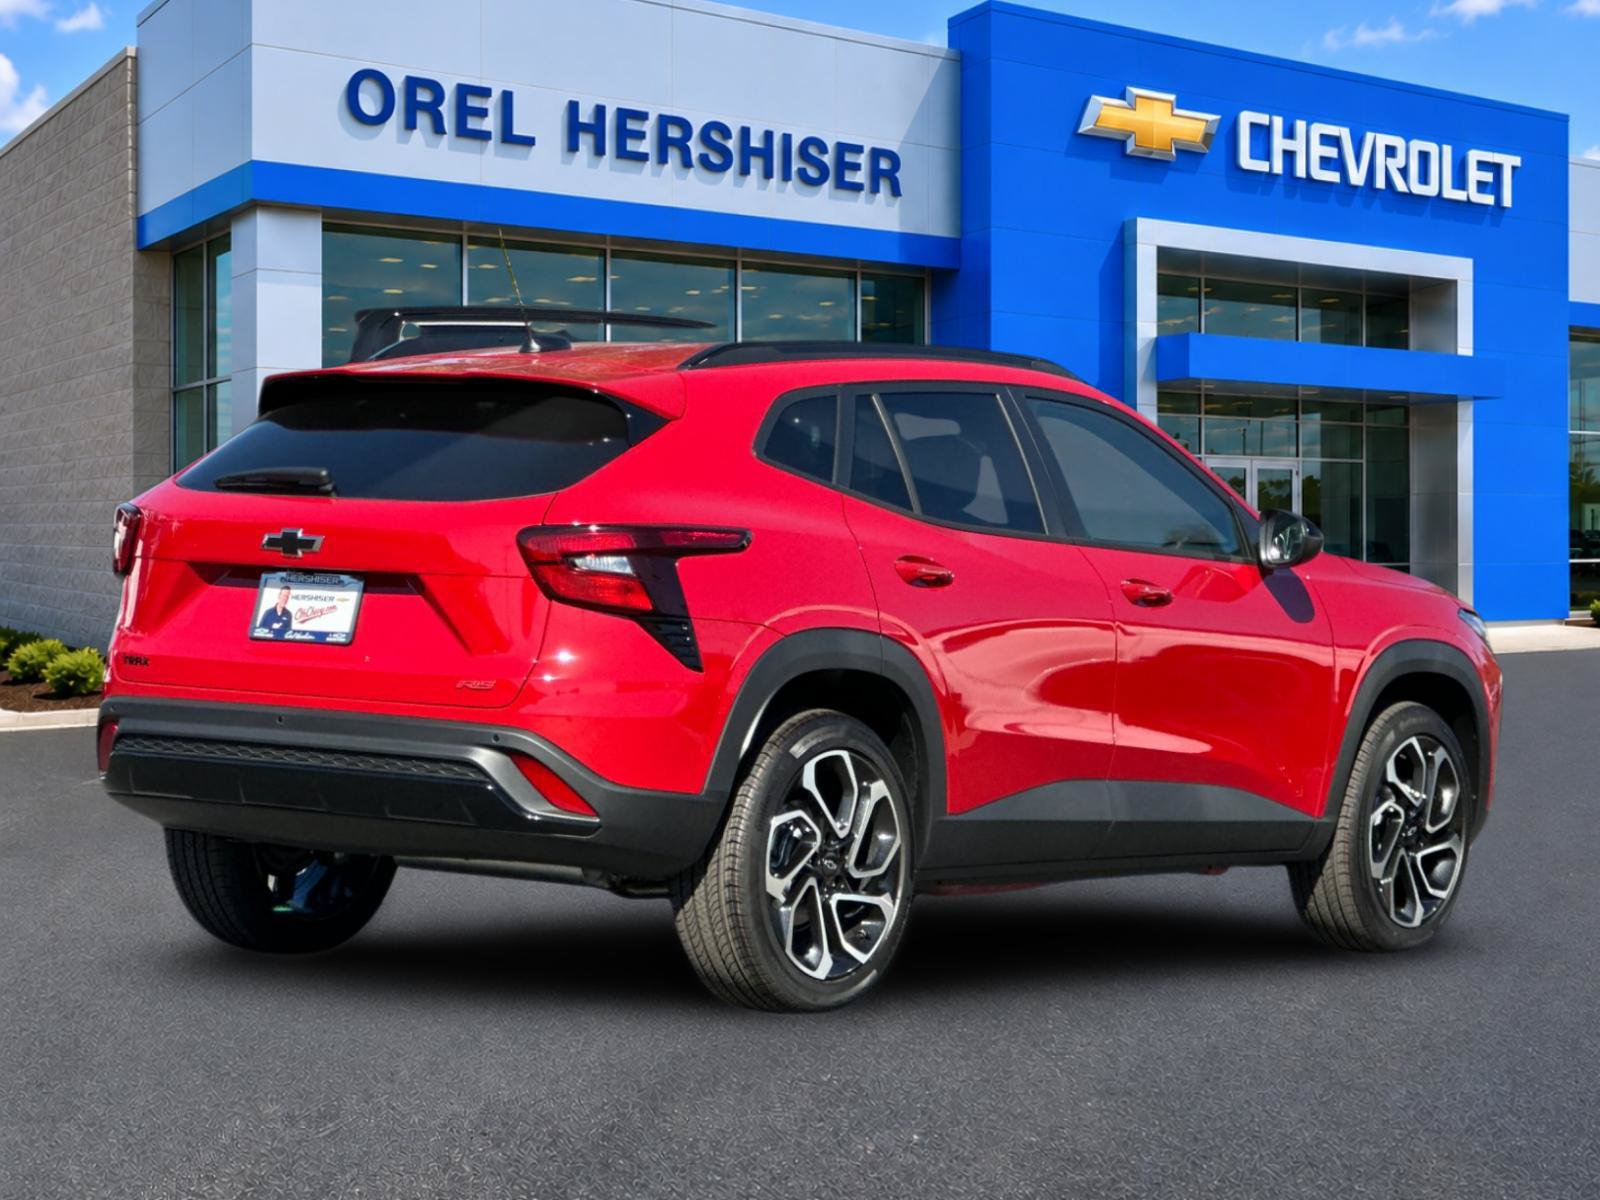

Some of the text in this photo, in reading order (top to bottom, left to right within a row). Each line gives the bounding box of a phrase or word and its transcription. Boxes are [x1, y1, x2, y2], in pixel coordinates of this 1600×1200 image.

[346, 69, 902, 197] OREL HERSHISER
[1236, 109, 1522, 208] CHEVROLET
[286, 574, 340, 585] HERSHISER
[291, 594, 335, 602] HERSHISER
